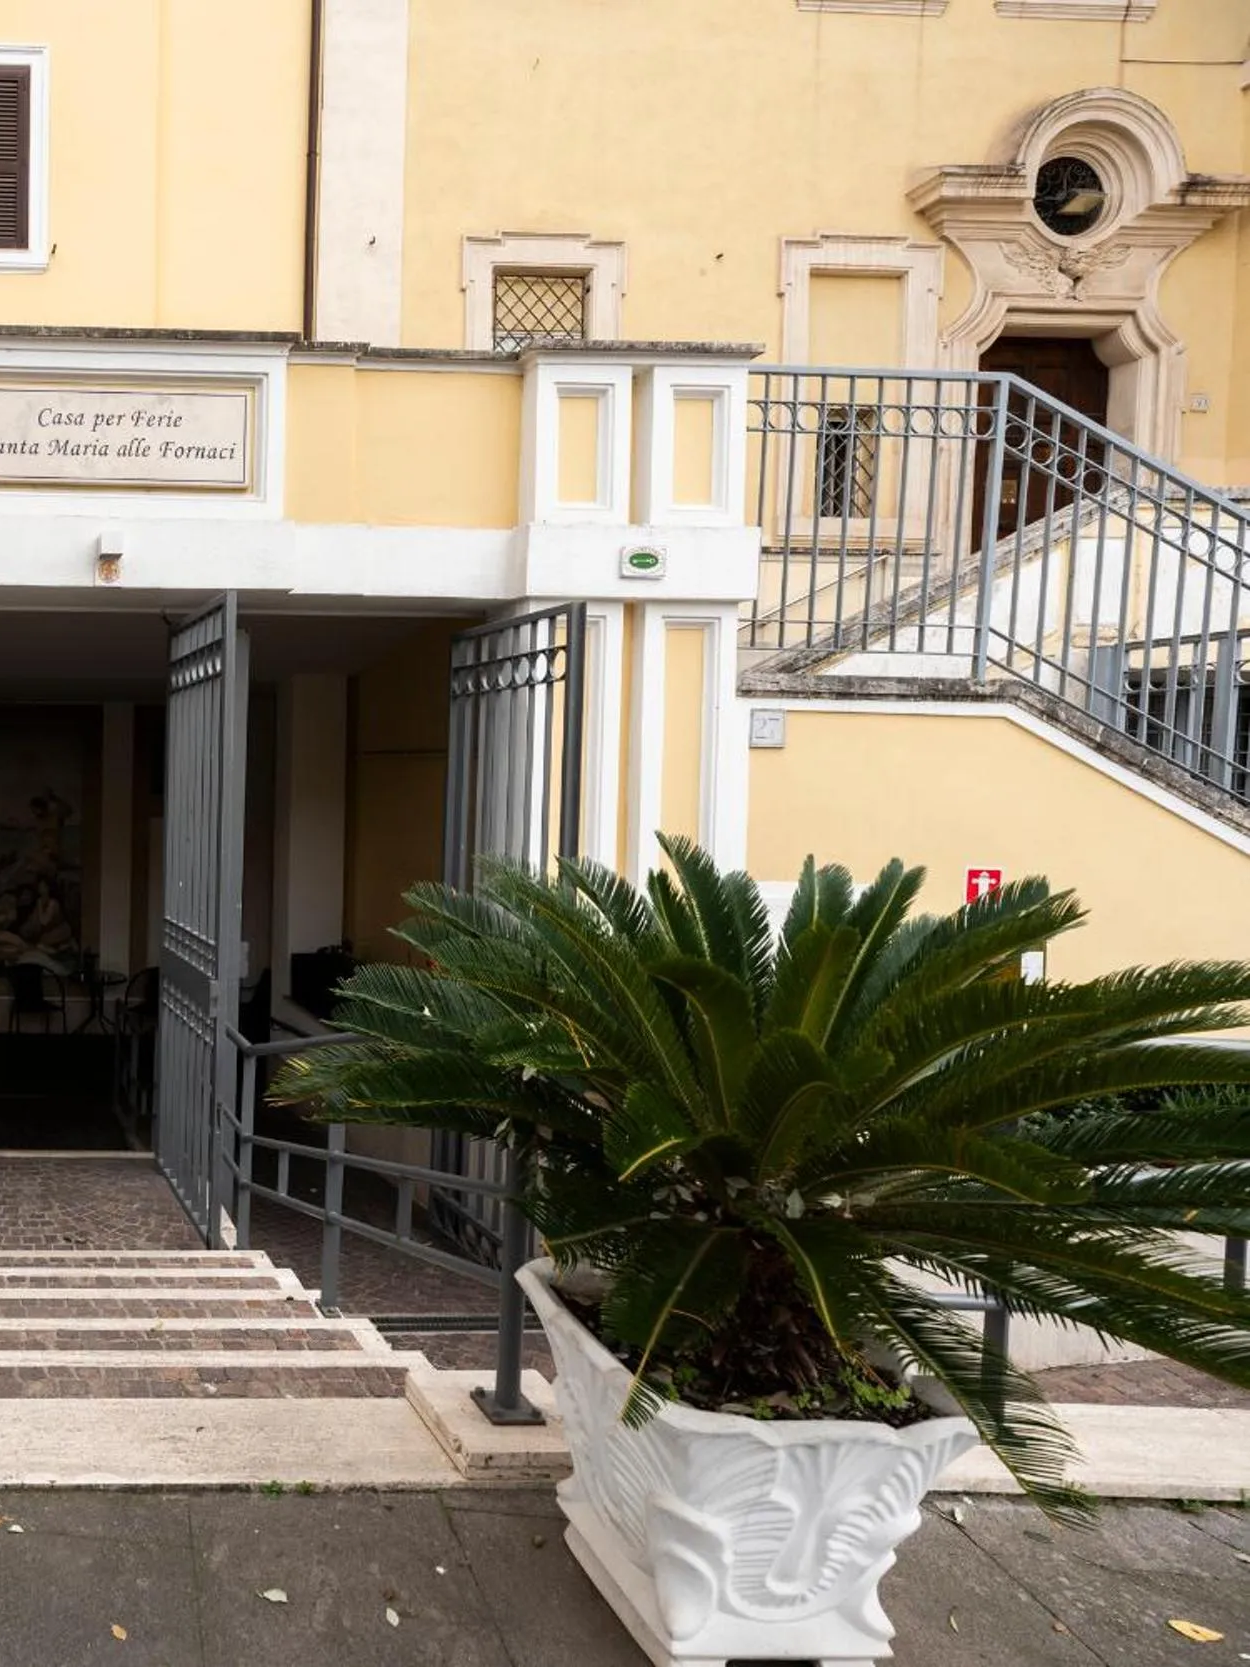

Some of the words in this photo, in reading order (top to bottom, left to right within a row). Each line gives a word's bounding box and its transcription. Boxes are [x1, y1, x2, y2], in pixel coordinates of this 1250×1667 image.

[37, 407, 86, 427] Casa
[91, 412, 126, 432] per
[130, 409, 183, 428] Ferie
[47, 438, 110, 458] Maria
[116, 437, 151, 458] alle
[159, 440, 237, 461] Fornaci
